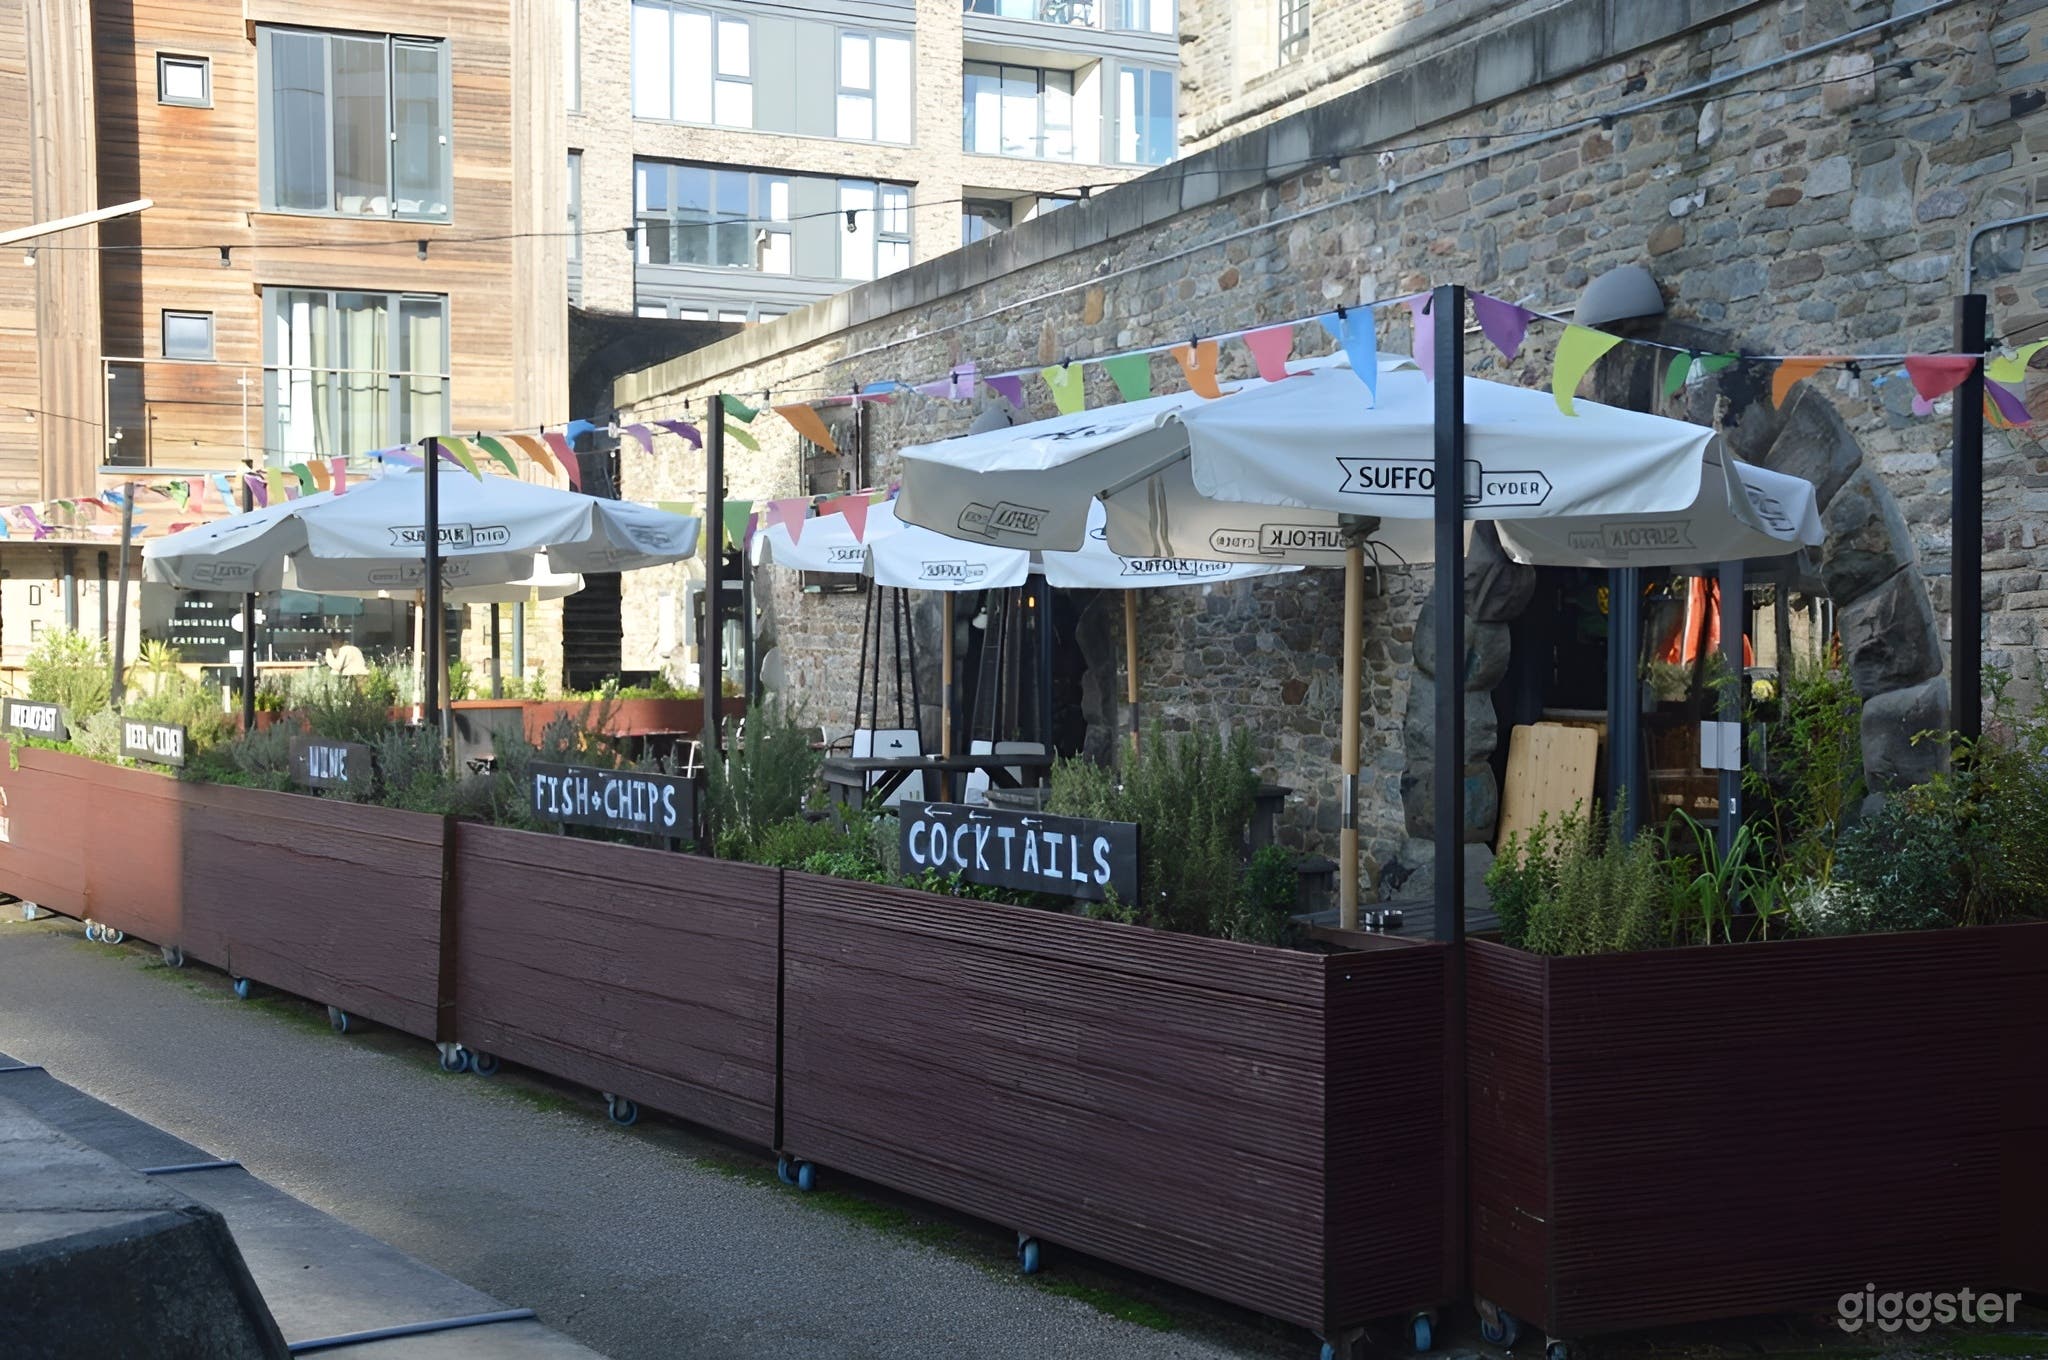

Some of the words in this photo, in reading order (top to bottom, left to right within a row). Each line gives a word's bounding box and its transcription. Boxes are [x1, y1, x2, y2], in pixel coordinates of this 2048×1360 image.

[1359, 466, 1435, 490] SUFFO
[1487, 482, 1540, 496] CYDER
[536, 773, 589, 816] FISH
[604, 778, 677, 827] CHIPS
[908, 819, 1112, 886] COCKTAILS
